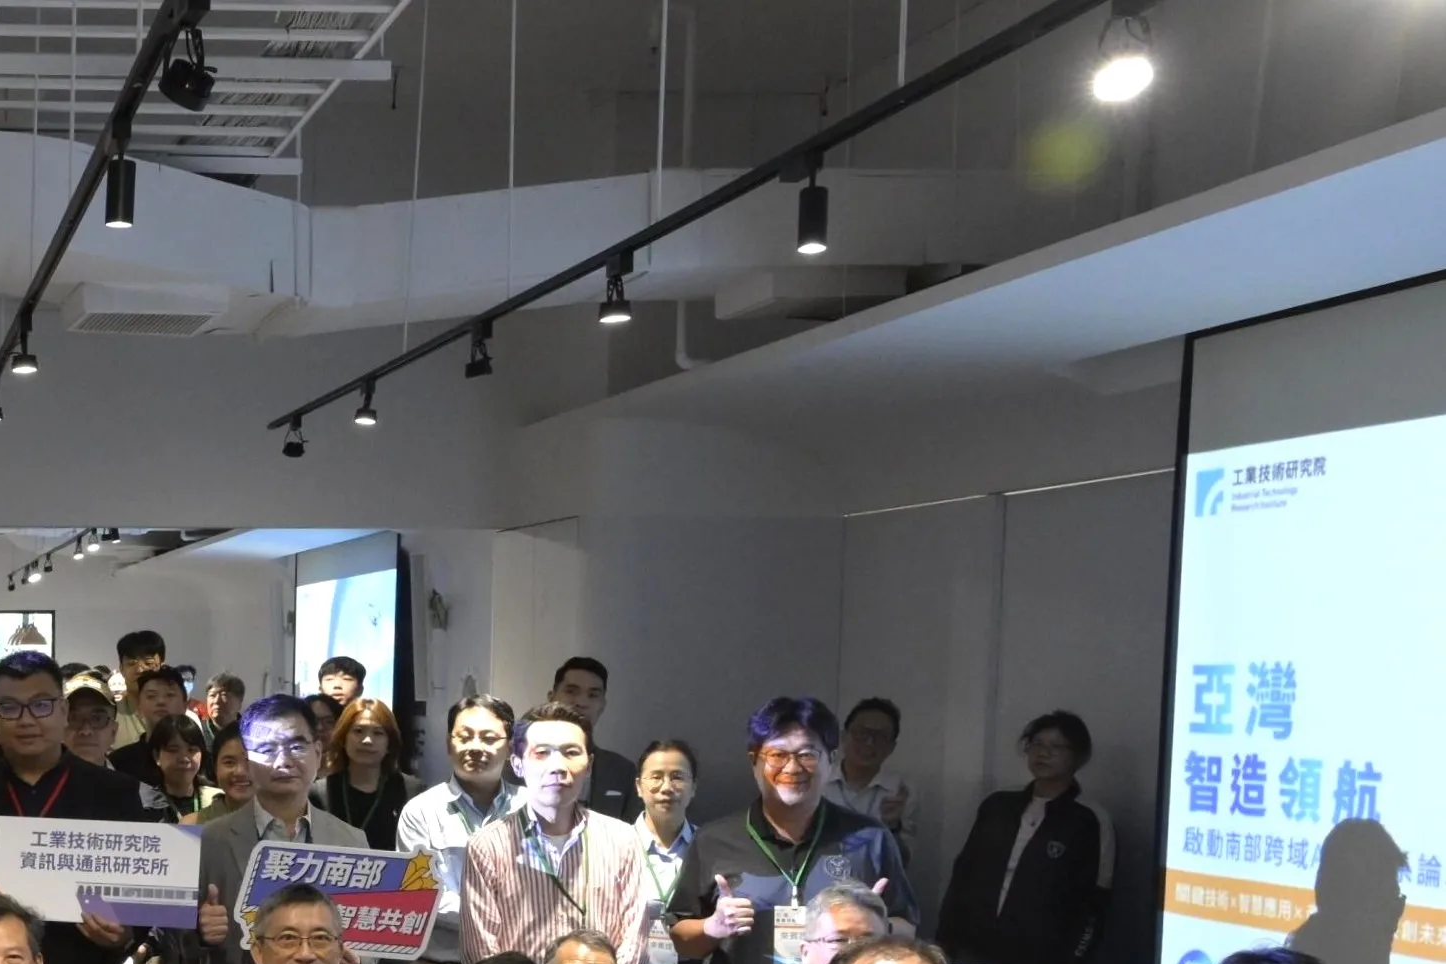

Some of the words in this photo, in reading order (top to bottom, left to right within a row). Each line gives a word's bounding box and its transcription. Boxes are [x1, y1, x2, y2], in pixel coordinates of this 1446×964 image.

[1232, 456, 1326, 486] 工業技術研究院
[1188, 660, 1297, 740] 亞灣
[1184, 750, 1383, 824] 智造領航
[30, 830, 162, 853] 工業技術研究院
[20, 851, 169, 876] 資訊與通訊研究所
[262, 850, 385, 889] 聚力南部
[336, 903, 428, 936] 智慧共創
